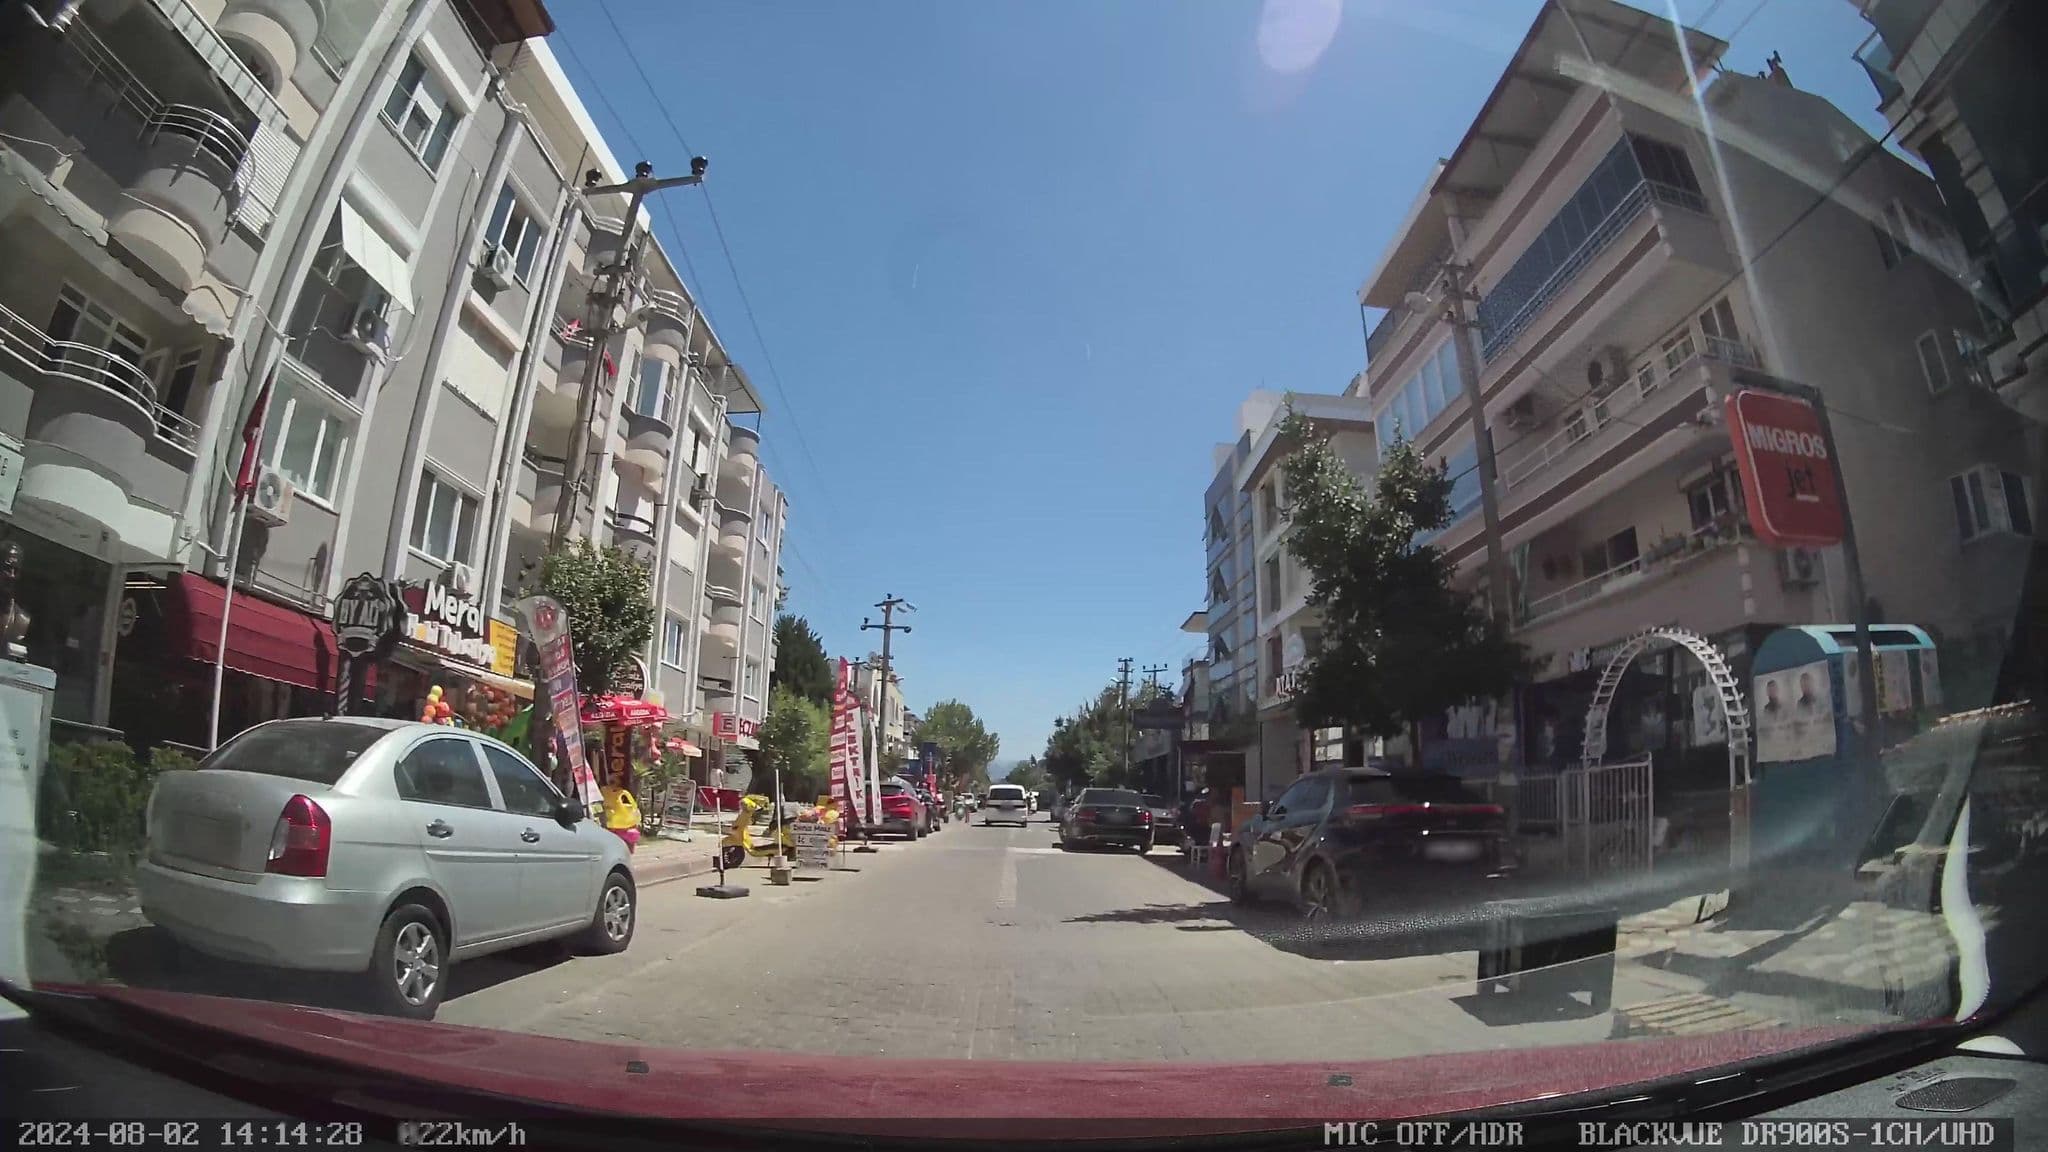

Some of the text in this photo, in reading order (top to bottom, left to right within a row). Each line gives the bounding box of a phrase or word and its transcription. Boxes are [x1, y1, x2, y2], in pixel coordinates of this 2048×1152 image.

[1747, 421, 1827, 459] MIGROS
[1785, 460, 1816, 498] jet
[424, 581, 485, 636] Meral
